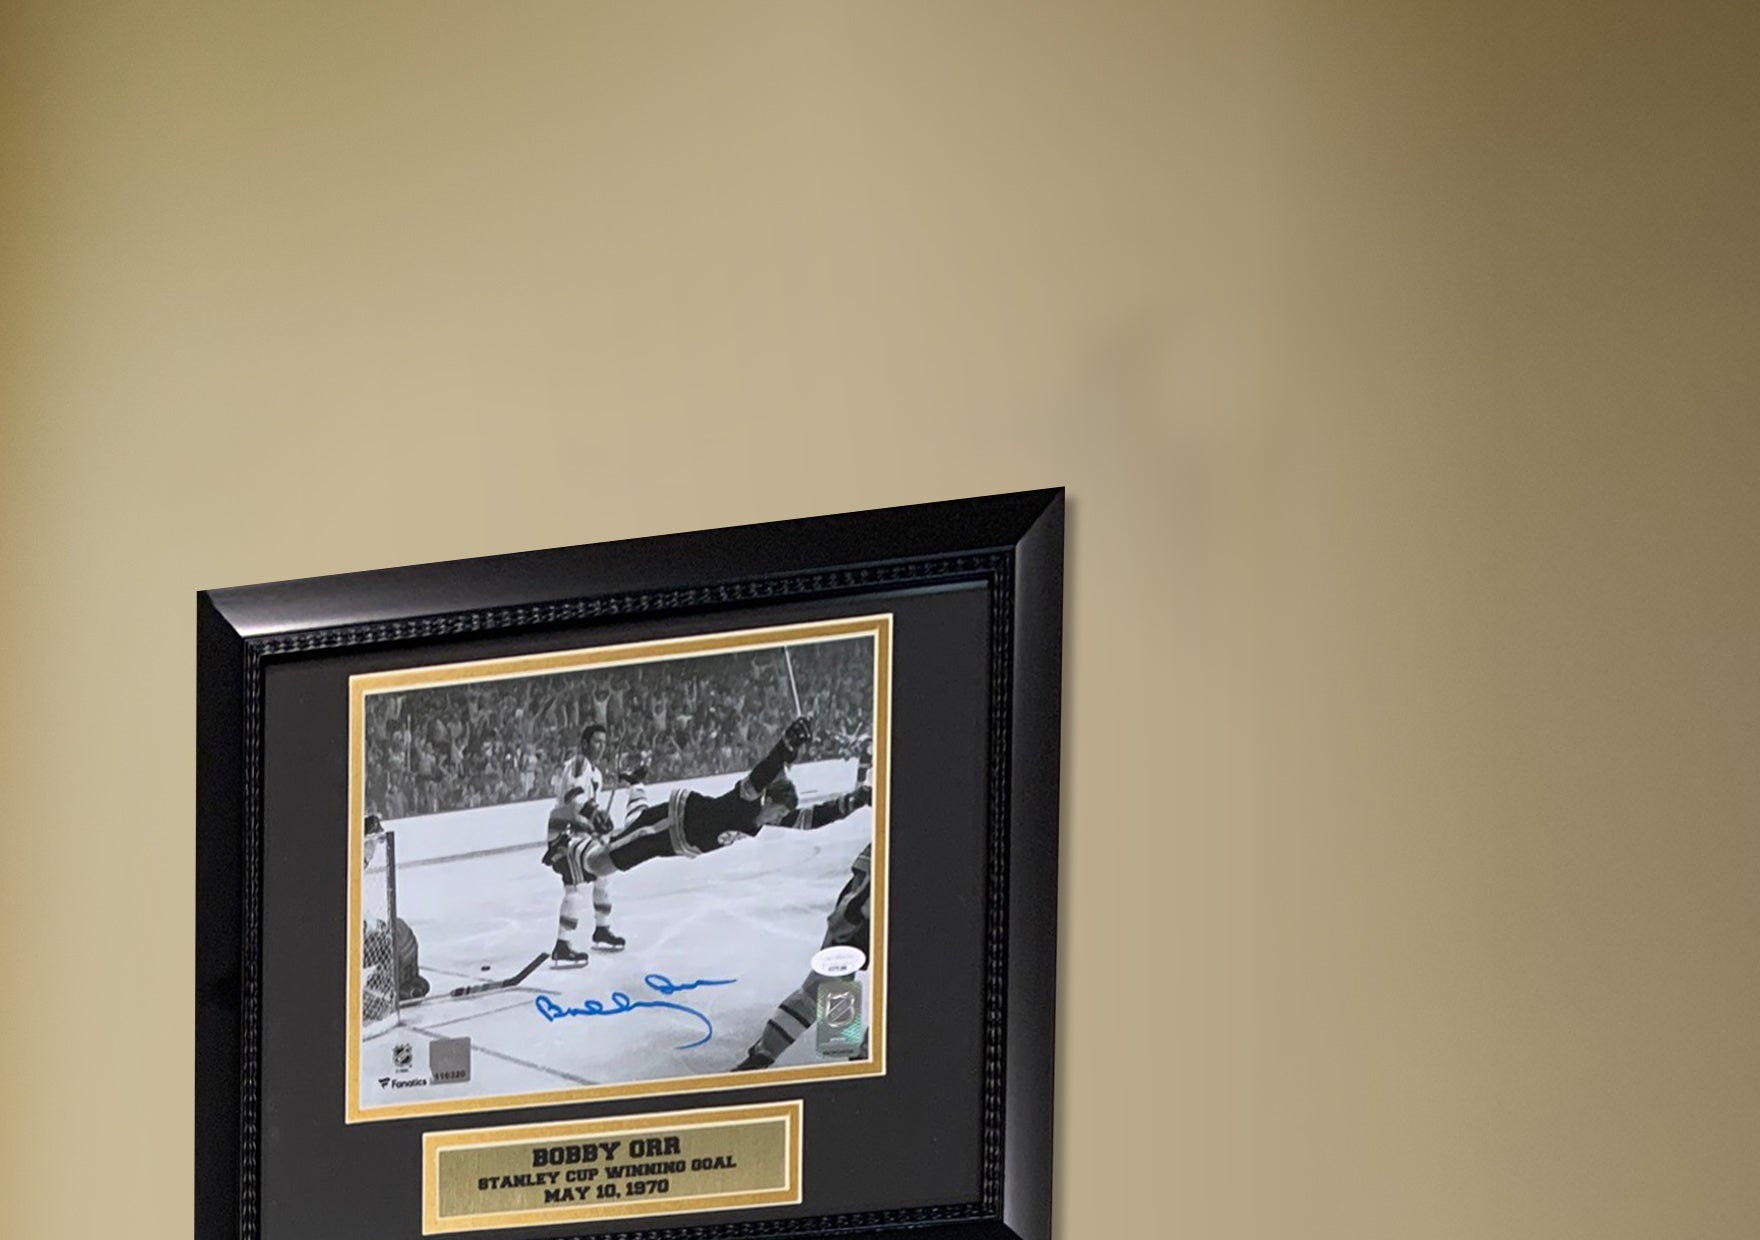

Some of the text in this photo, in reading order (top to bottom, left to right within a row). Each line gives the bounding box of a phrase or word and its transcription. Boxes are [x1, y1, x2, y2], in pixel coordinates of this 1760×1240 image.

[391, 1078, 427, 1089] Fanatics
[532, 1136, 681, 1168] BOBBY ORR
[478, 1155, 737, 1191] STANLEY CUP WINNING GOAL
[544, 1178, 669, 1203] MAY 10, 1970
